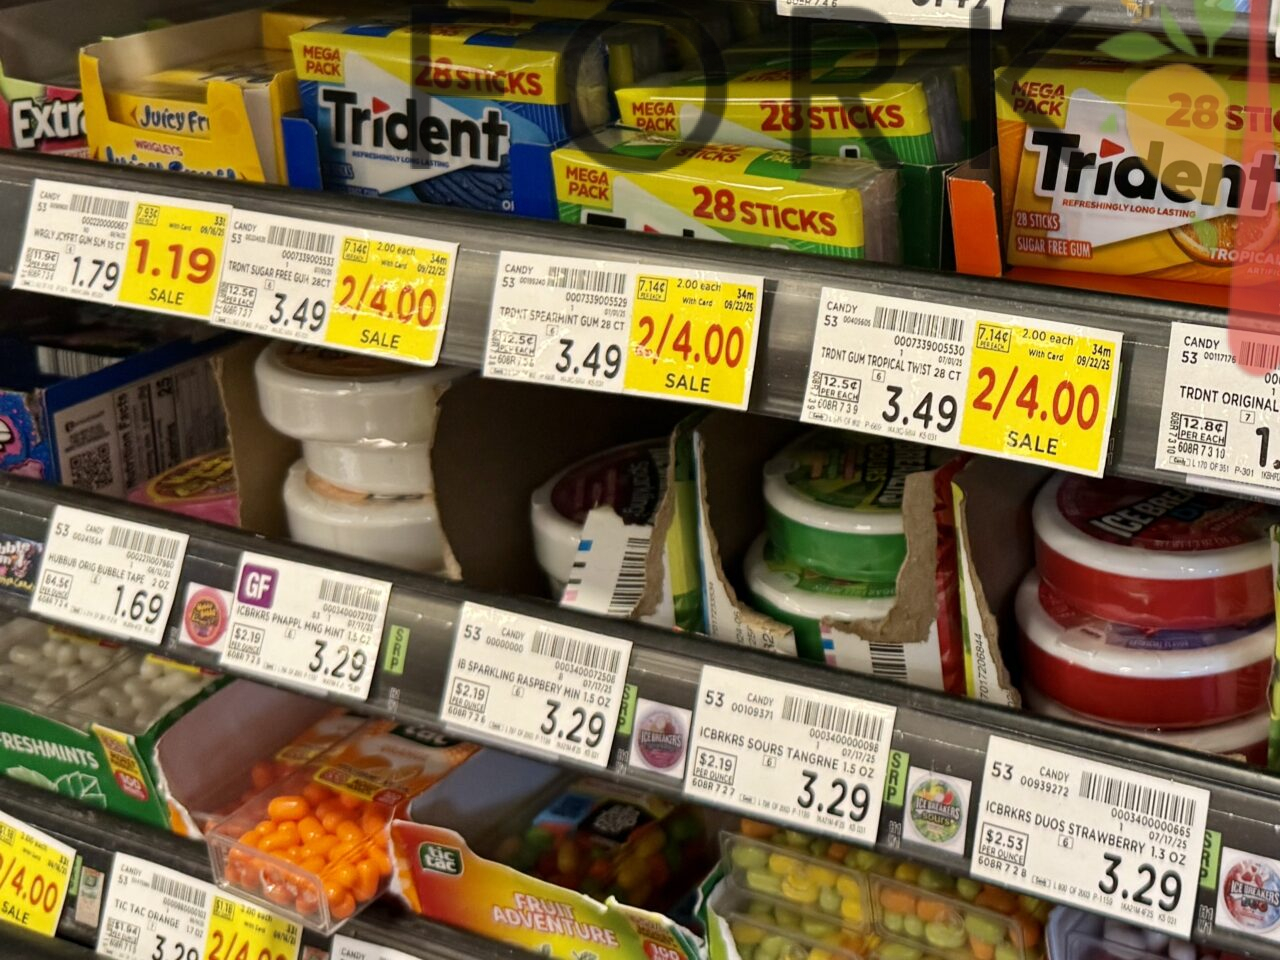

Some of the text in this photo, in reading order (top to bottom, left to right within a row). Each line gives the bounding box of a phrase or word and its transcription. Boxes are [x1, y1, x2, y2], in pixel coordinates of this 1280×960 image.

[303, 46, 341, 61] MEGA
[307, 60, 340, 75] PACK
[415, 56, 543, 97] 28 STICKS
[1012, 81, 1065, 100] MEGA
[139, 104, 186, 133] Juicy
[631, 102, 675, 116] MEGA
[760, 101, 904, 131] 28 STICKS
[1014, 98, 1064, 116] PACK
[1166, 94, 1219, 130] 28
[323, 89, 508, 161] Trident
[636, 116, 675, 131] PACK
[566, 167, 609, 186] MEGA
[568, 183, 609, 201] PACK
[693, 187, 838, 236] 28 STICKS
[1016, 212, 1058, 230] 28 STICKS
[1062, 199, 1196, 218] REFRESHINGLY LONG LASTING
[1018, 237, 1090, 258] SUGAR FREE GUM
[72, 256, 120, 291] 1.79
[134, 240, 215, 284] 1.19
[150, 288, 184, 305] SALE
[340, 275, 436, 327] 2/4.00
[270, 293, 326, 331] 3.49
[360, 329, 400, 350] SALE
[638, 314, 743, 367] 2/4.00
[1184, 336, 1220, 349] CANDY
[555, 339, 622, 378] 3.49
[665, 373, 710, 393] SALE
[882, 385, 958, 432] 3.49
[973, 366, 1099, 430] 2/4.00
[1180, 386, 1220, 403] TRDNT
[1223, 392, 1280, 413] ORIGINAL
[1006, 430, 1058, 456] SALE
[245, 573, 272, 601] GF
[113, 585, 162, 624] 1.69
[308, 640, 367, 682] 3.29
[541, 701, 605, 748] 3.29
[1039, 766, 1069, 782] CANDY
[797, 770, 870, 822] 3.29
[986, 801, 1186, 865] ICBRKRS DUOS STRAWBERRY 1.3 OZ
[425, 857, 456, 873] tac
[428, 846, 455, 860] tic
[1098, 853, 1181, 912] 3.29
[514, 894, 575, 920] FRUIT
[493, 906, 618, 947] ADVENTURE
